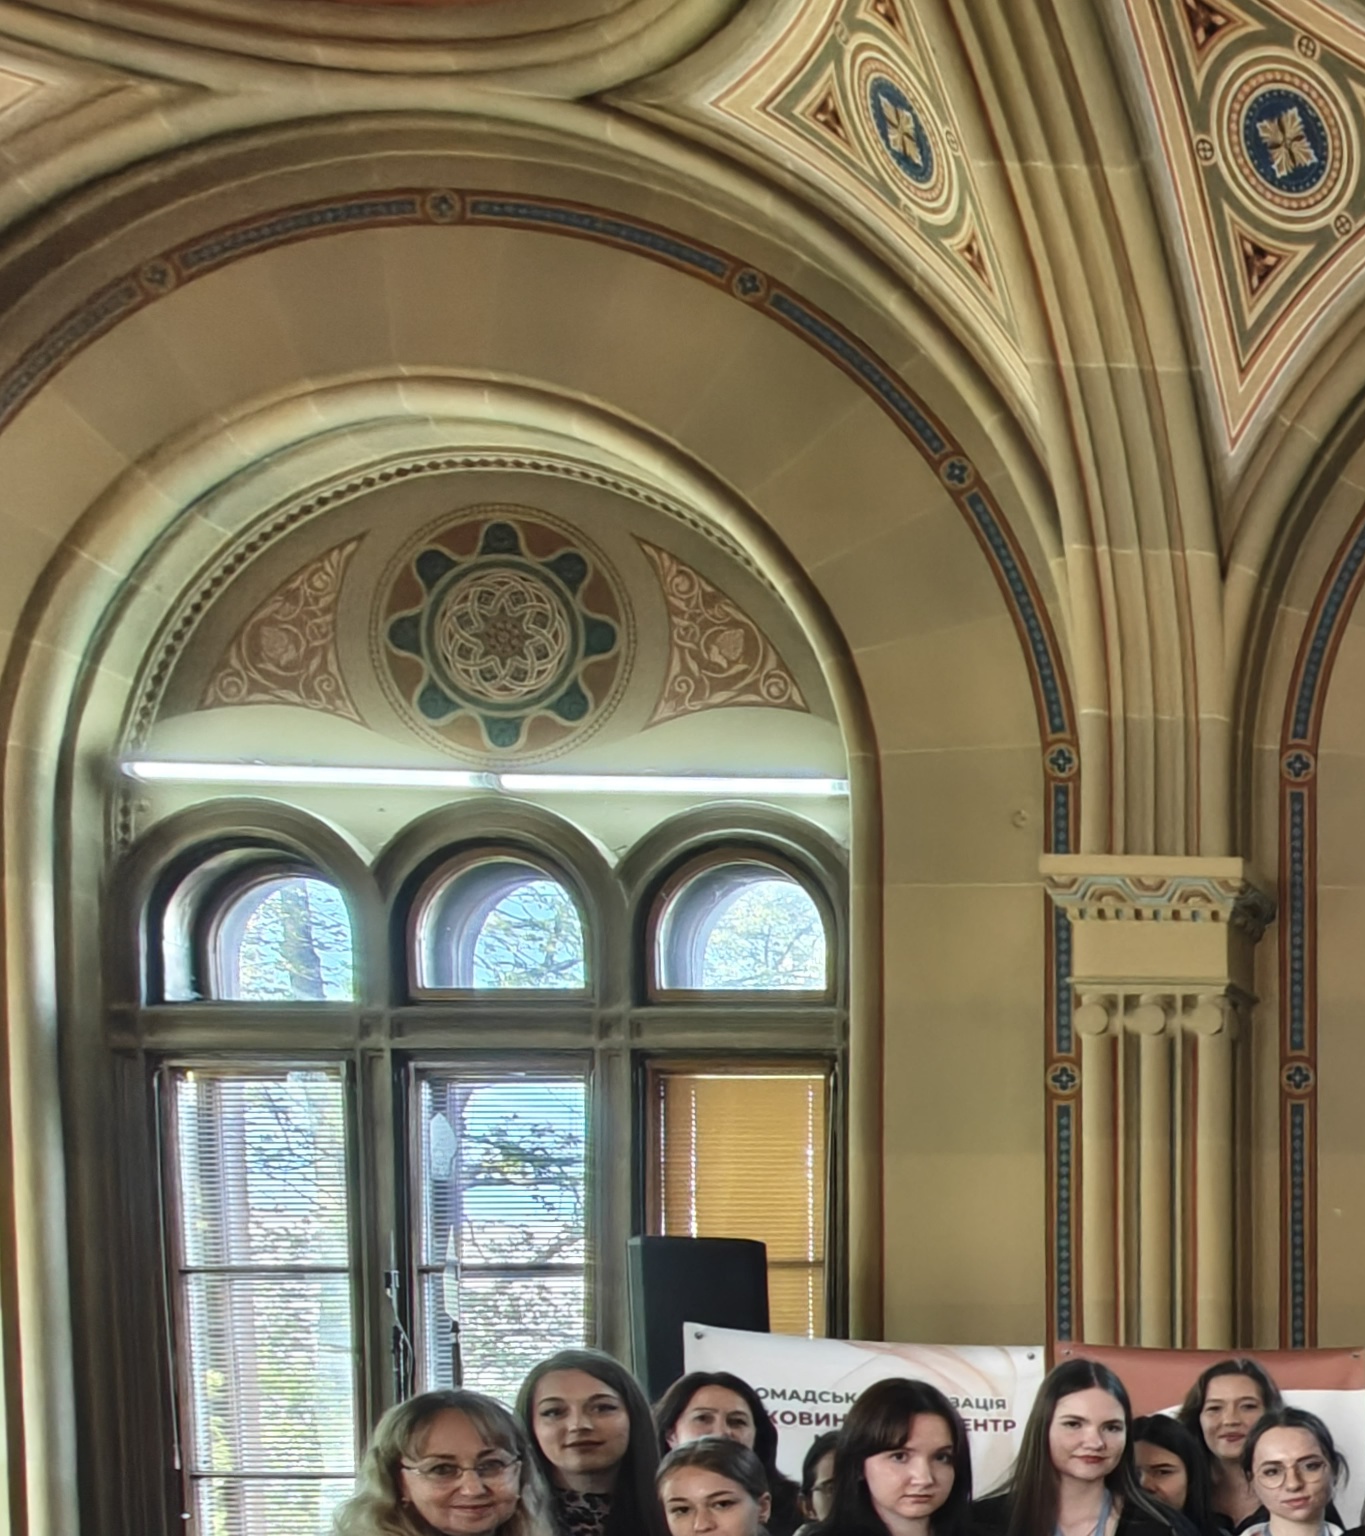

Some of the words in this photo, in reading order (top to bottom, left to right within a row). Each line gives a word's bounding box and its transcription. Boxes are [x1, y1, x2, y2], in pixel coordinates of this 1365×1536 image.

[755, 1387, 857, 1405] ОМАДСЬК
[949, 1396, 1007, 1411] ЗАЦІЯ
[962, 1418, 1017, 1432] ЕНТР
